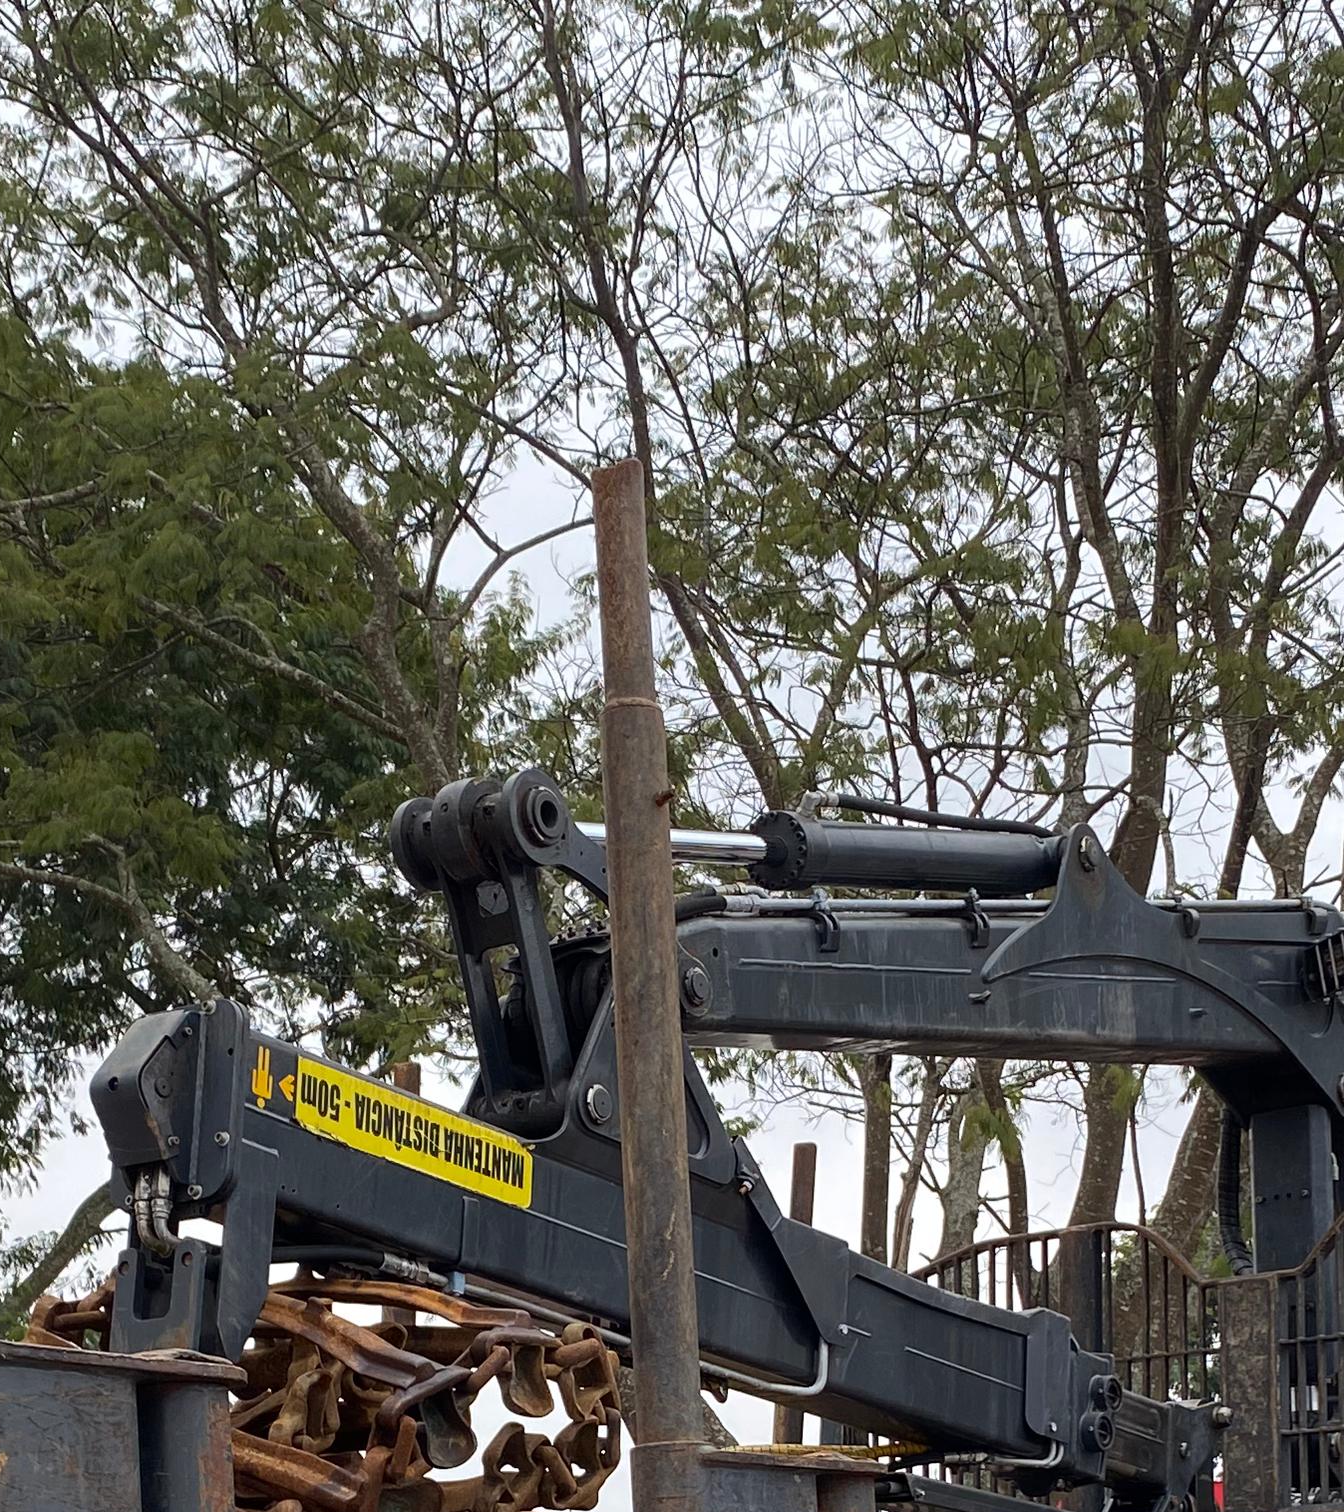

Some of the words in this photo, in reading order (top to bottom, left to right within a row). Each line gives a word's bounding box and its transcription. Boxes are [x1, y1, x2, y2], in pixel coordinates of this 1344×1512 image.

[301, 1072, 341, 1122] 50m
[355, 1092, 441, 1159] DISTÂNCIA
[444, 1127, 524, 1188] MANTENHA
